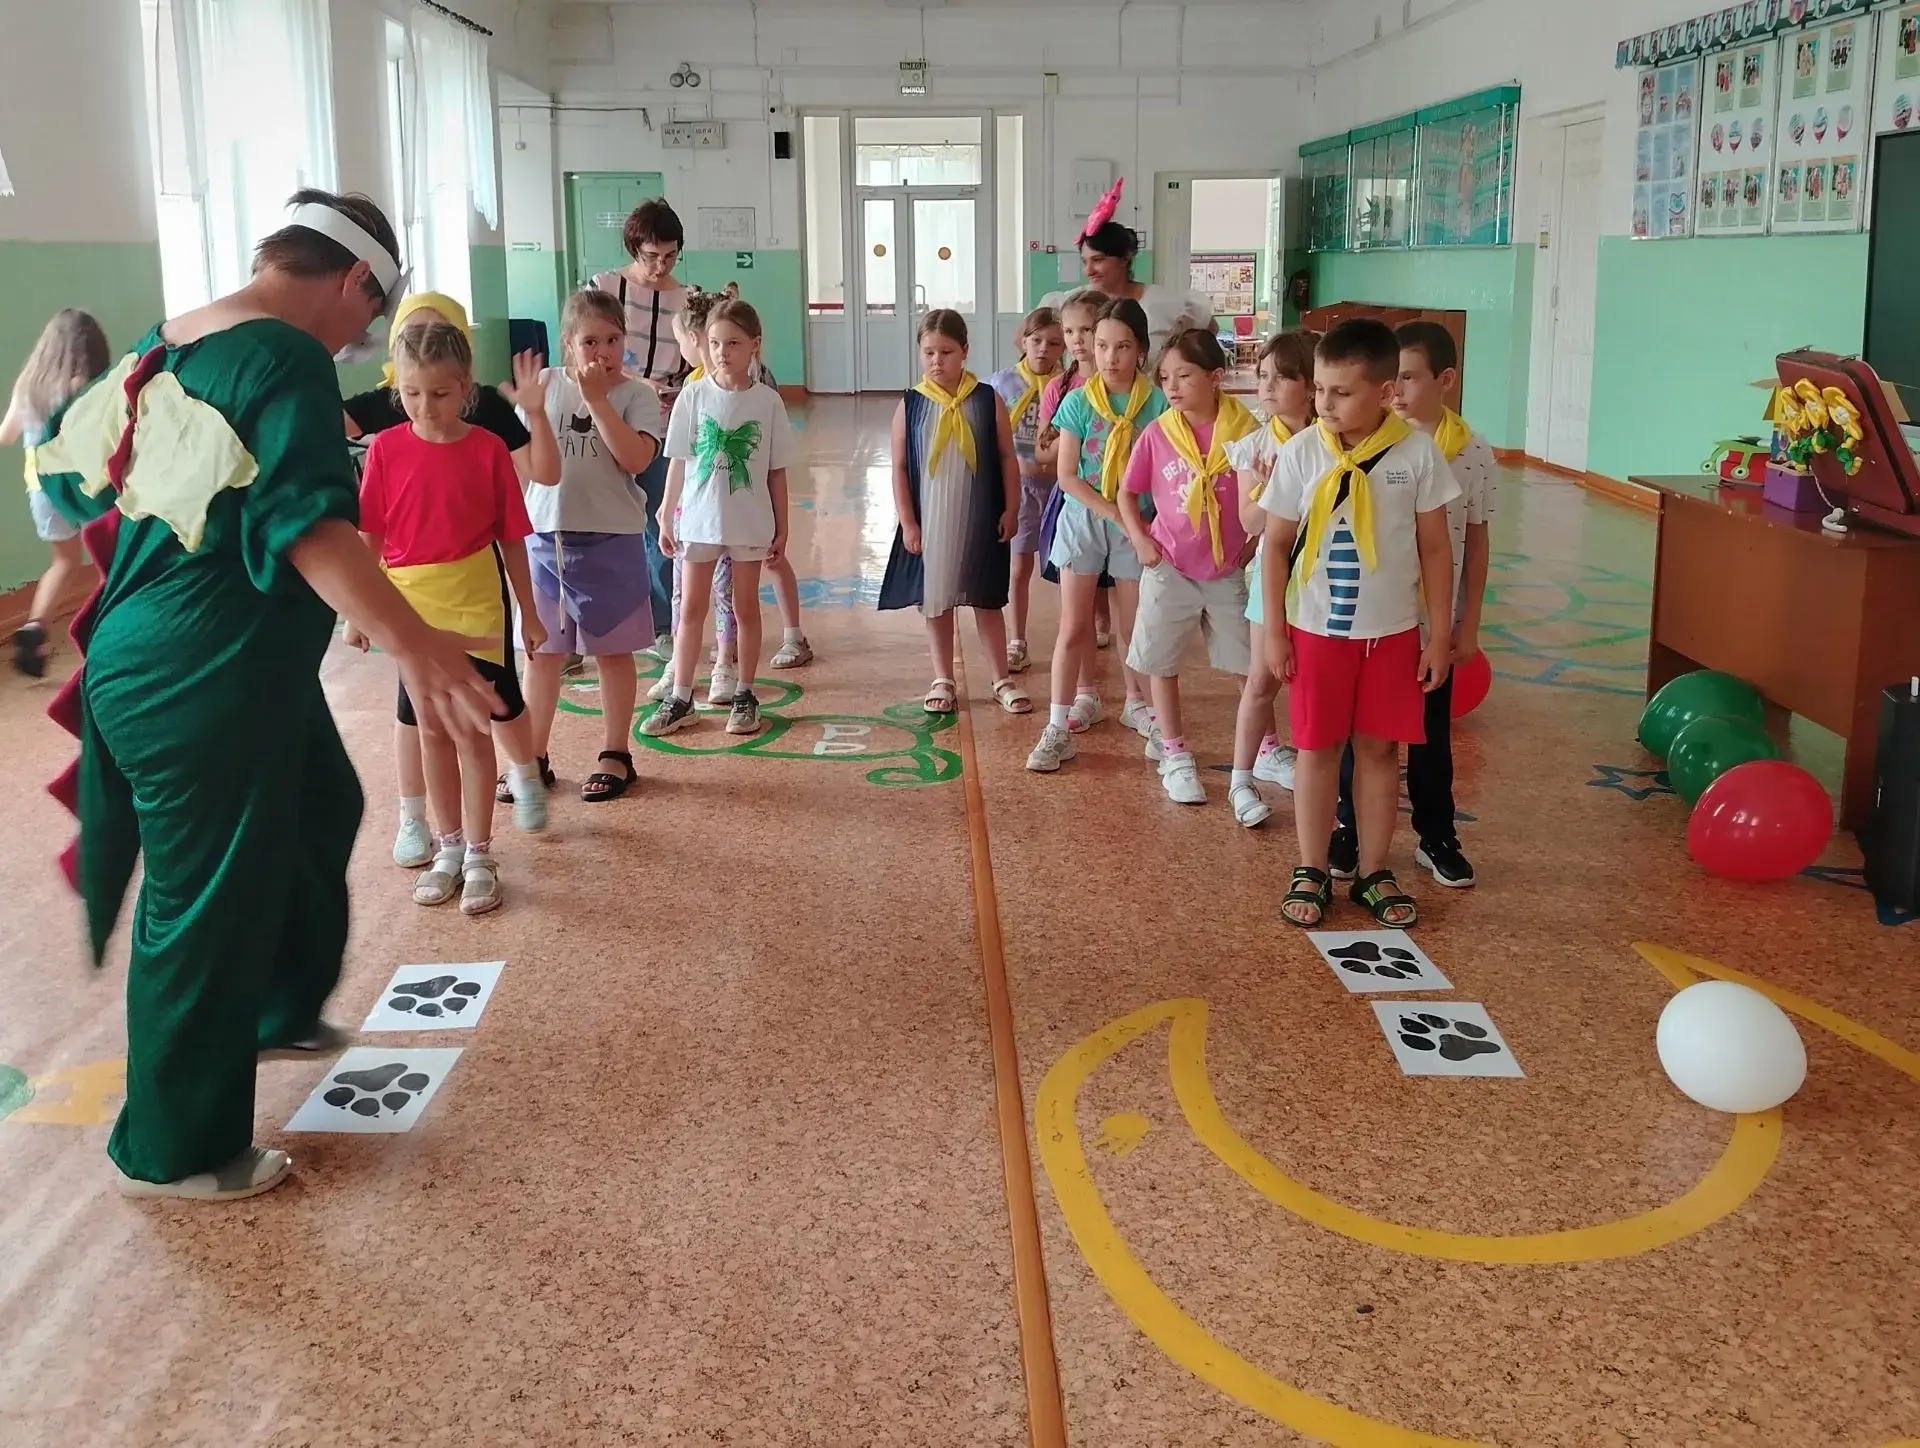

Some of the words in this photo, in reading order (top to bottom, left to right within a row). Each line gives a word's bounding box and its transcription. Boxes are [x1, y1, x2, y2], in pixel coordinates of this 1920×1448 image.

[902, 86, 925, 94] ВЫХОД
[559, 413, 564, 432] I
[1162, 458, 1188, 481] BEA
